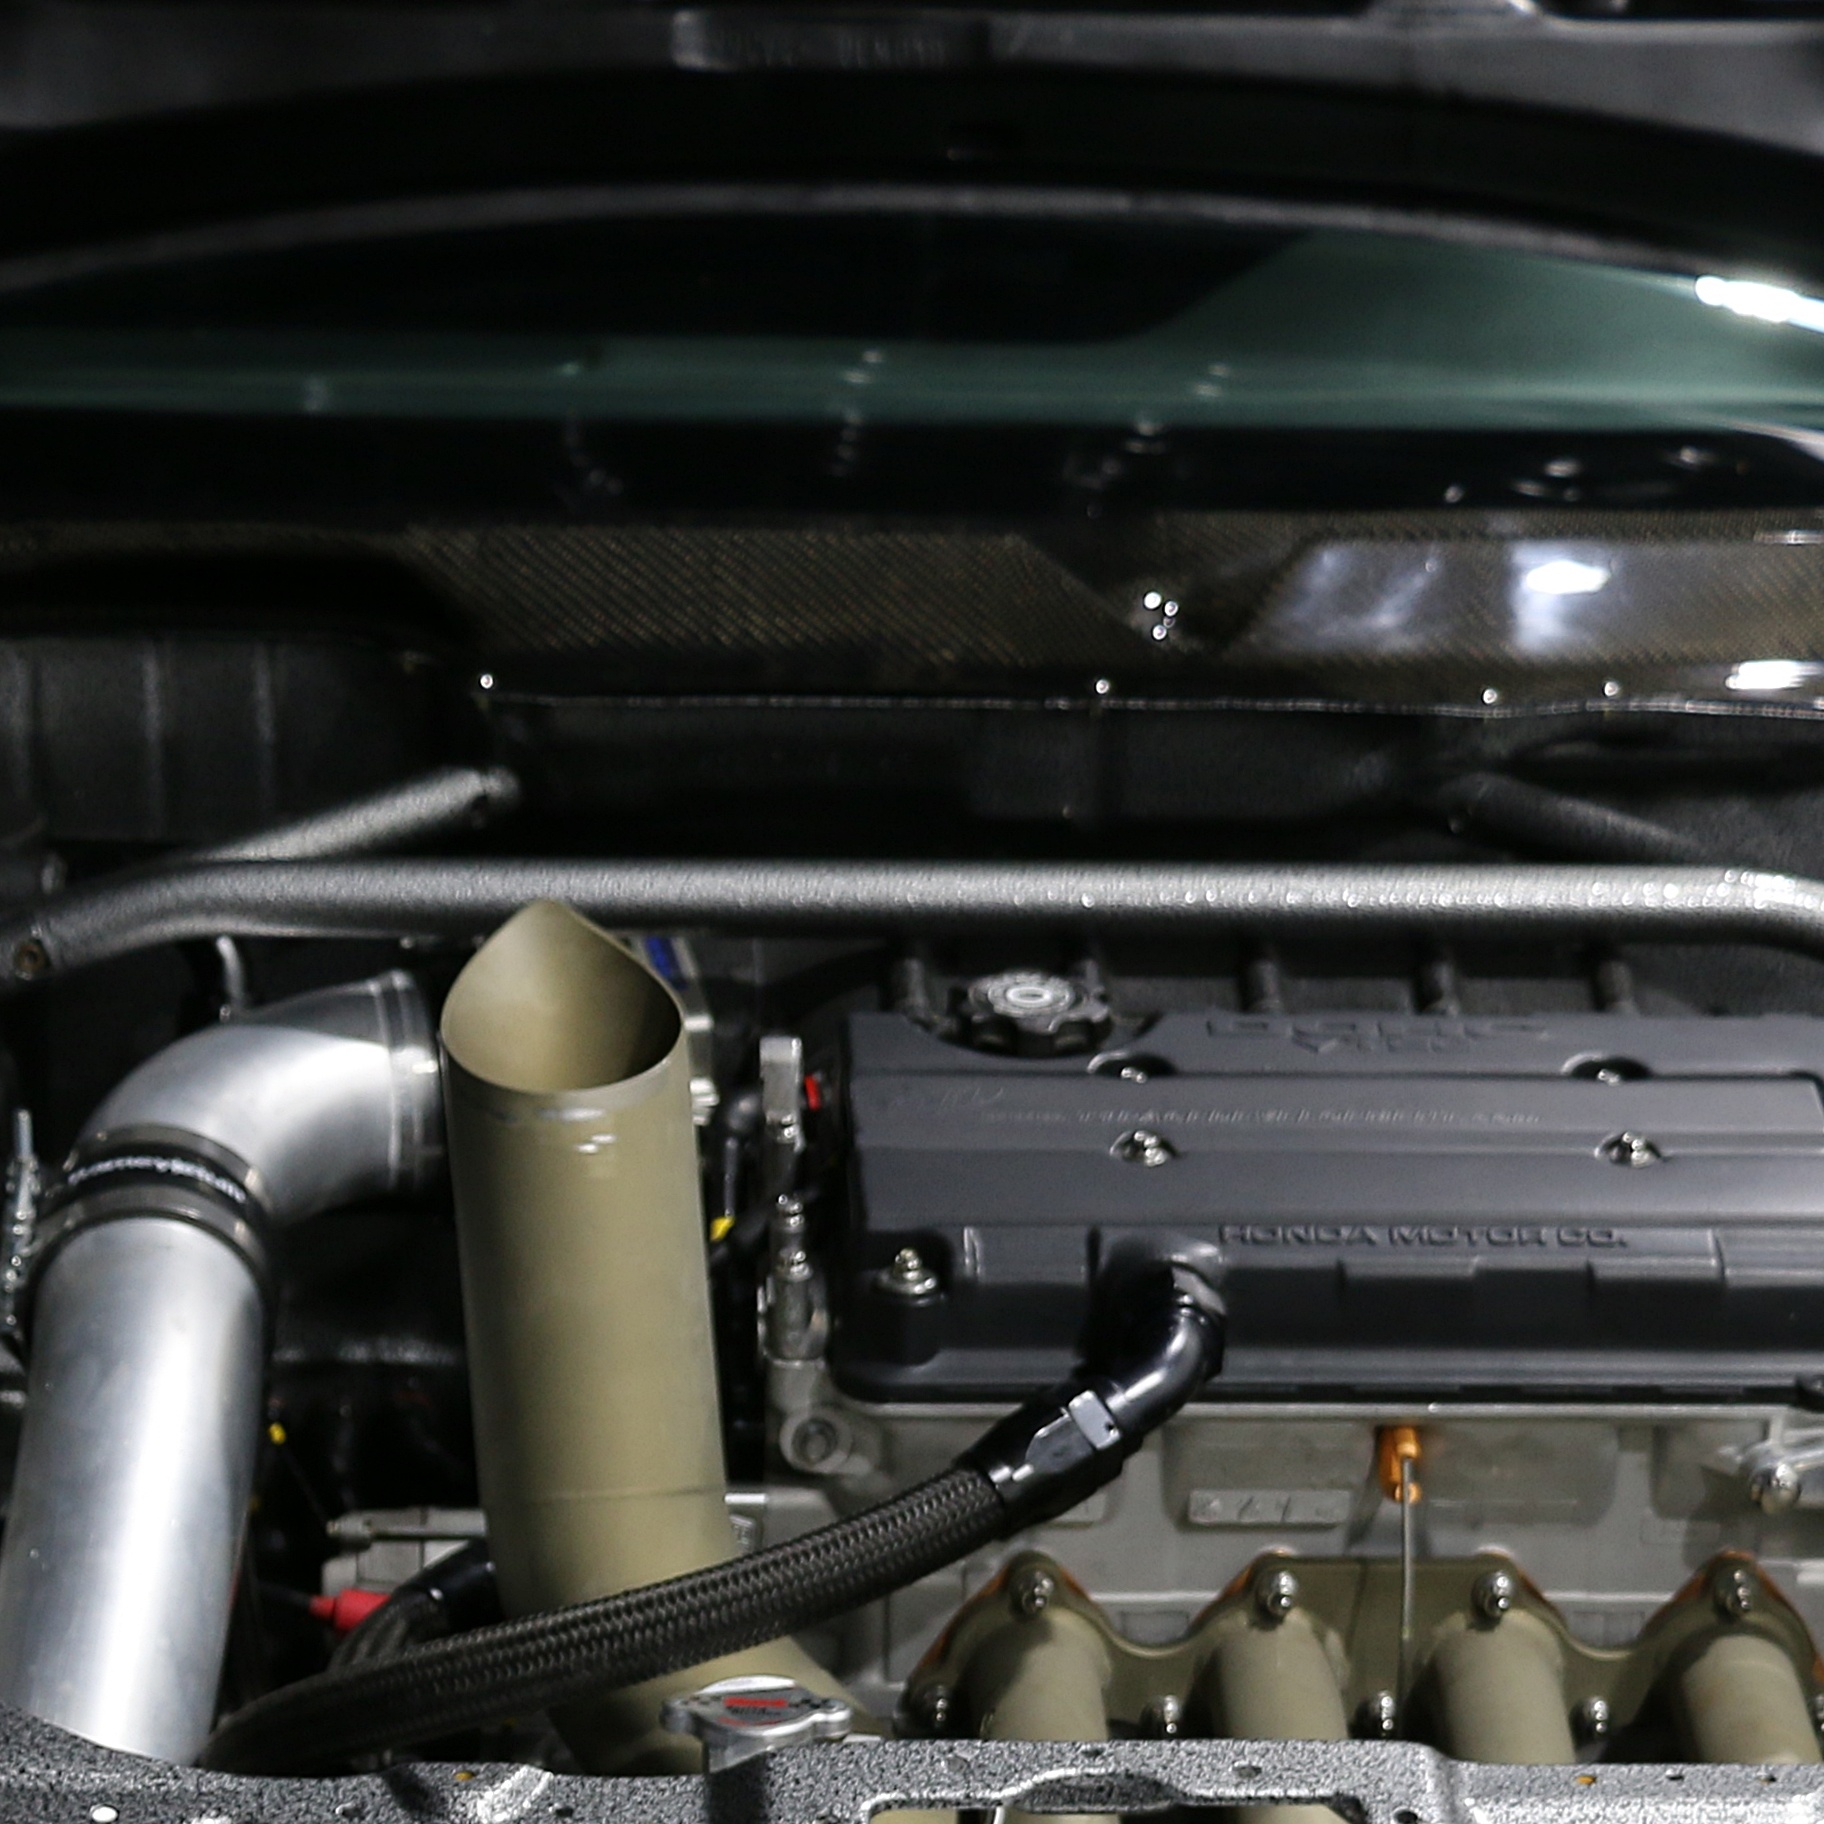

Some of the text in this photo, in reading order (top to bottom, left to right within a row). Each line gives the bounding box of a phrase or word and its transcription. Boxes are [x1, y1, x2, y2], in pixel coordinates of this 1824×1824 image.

[1218, 1223, 1629, 1249] HONDA MOTOR CO.
